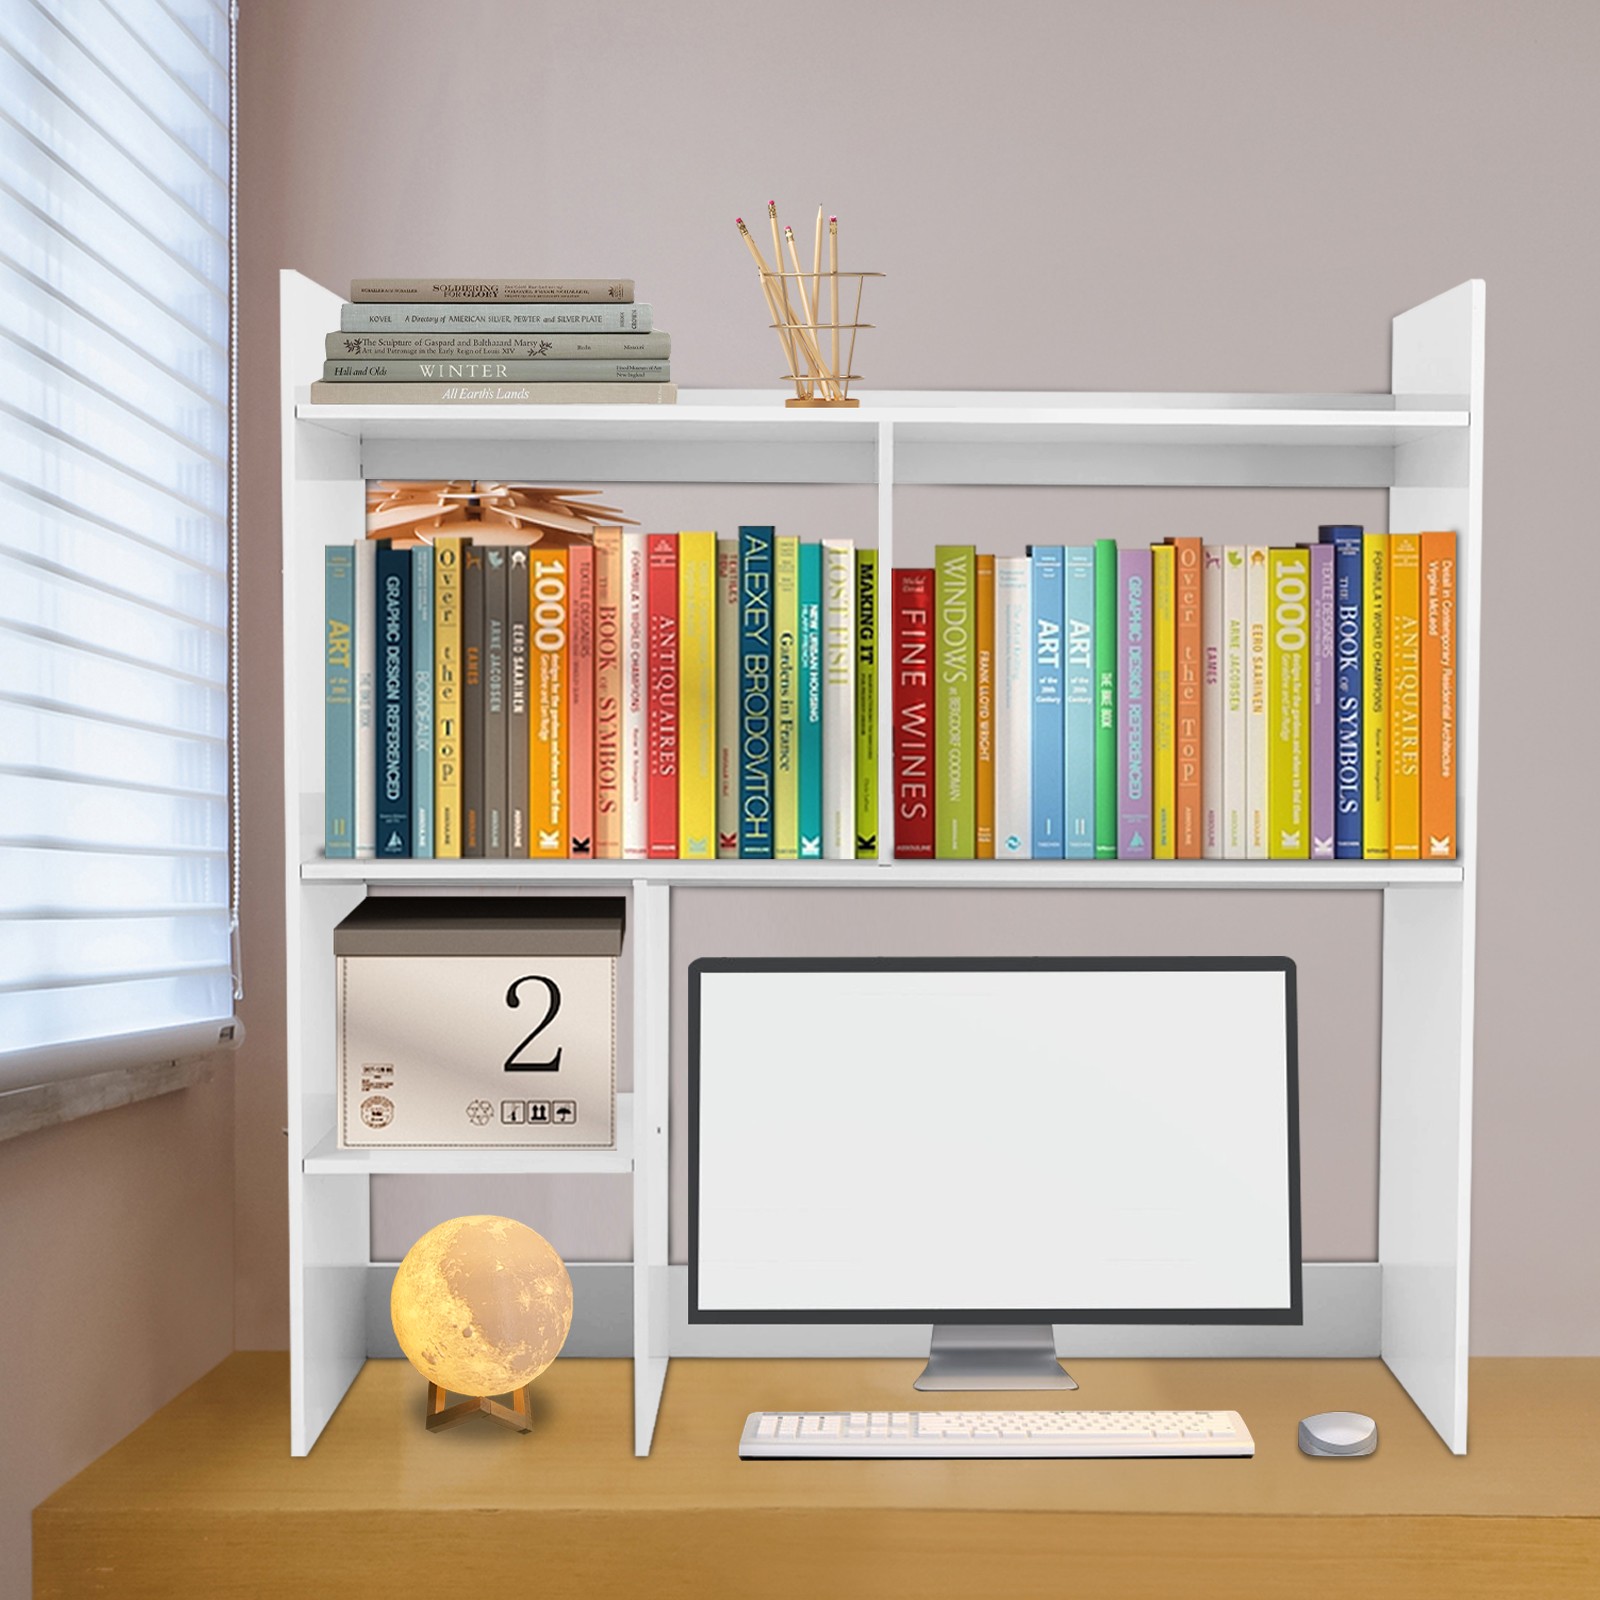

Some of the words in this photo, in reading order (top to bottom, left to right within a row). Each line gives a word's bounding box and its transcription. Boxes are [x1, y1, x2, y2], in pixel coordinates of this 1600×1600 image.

[362, 338, 376, 348] The
[378, 338, 412, 348] Sculpture
[414, 338, 422, 348] of
[424, 338, 455, 348] Gaspard
[457, 338, 470, 348] and
[473, 338, 511, 348] Balthazard
[514, 338, 538, 348] Marsy
[405, 316, 410, 324] A
[412, 316, 438, 324] Directory
[440, 316, 446, 324] of
[449, 316, 486, 324] AMERICAN
[488, 316, 511, 324] SILVER,
[514, 316, 540, 324] PEWTER
[543, 316, 555, 324] and
[557, 316, 580, 324] SILVER
[582, 316, 602, 324] PLATE
[334, 367, 351, 376] Hall
[353, 367, 368, 376] and
[369, 367, 387, 376] Olds
[419, 364, 507, 377] WINTER
[442, 388, 457, 399] All
[459, 388, 493, 399] Earth's
[496, 388, 529, 399] Lands
[580, 562, 590, 599] TEXTILE
[630, 551, 640, 602] FORMULA
[728, 554, 737, 604] TEXTILES
[744, 535, 768, 645] ALEXEY
[828, 548, 848, 618] LOST
[1181, 549, 1195, 622] Over
[1322, 560, 1332, 600] TEXTILE
[1339, 577, 1349, 600] THE
[1373, 551, 1382, 602] FORMULA
[1428, 561, 1439, 596] Virginia
[1441, 560, 1451, 587] Detail
[1441, 589, 1451, 598] in
[385, 576, 400, 642] GRAPHIC
[534, 560, 565, 651] 1000
[809, 604, 819, 629] NEW
[860, 563, 873, 641] MAKING
[943, 555, 967, 683] WINDOWS
[1128, 576, 1142, 642] GRAPHIC
[1275, 560, 1306, 651] 1000
[1428, 598, 1439, 636] McLeod
[329, 620, 349, 668] ART
[489, 620, 501, 650] ARNE
[512, 624, 524, 653] EERO
[580, 602, 590, 658] DESIGNERS
[598, 606, 616, 672] BOOK
[630, 612, 640, 649] WORLD
[809, 631, 819, 669] URBAN
[860, 645, 873, 665] IT
[901, 610, 926, 686] FINE
[1038, 619, 1059, 668] ART
[1070, 619, 1090, 668] ART
[1229, 620, 1240, 649] ARNE
[1252, 624, 1263, 653] EERO
[1322, 603, 1332, 658] DESIGNERS
[1339, 605, 1358, 672] BOOK
[1373, 612, 1382, 649] WORLD
[1441, 600, 1451, 665] Contemporary
[385, 646, 400, 699] DESIGN
[467, 647, 478, 685] EAMES
[630, 651, 640, 712] CHAMPIONS
[779, 633, 794, 697] Gardens
[828, 627, 848, 686] FISH
[979, 651, 989, 683] FRANK
[1100, 673, 1112, 687] THE
[1128, 646, 1142, 699] DESIGN
[1183, 647, 1194, 700] the
[1206, 647, 1217, 685] EAMES
[1373, 651, 1382, 712] CHAMPIONS
[489, 654, 501, 712] JACOBSEN
[512, 656, 524, 713] SAARINEN
[656, 616, 675, 776] ANTIQUAIRES
[779, 700, 794, 715] in
[809, 672, 819, 722] HOUSING
[979, 686, 989, 718] LLOYD
[1100, 690, 1112, 706] BIKE
[1229, 653, 1240, 712] JACOBSEN
[1252, 656, 1263, 713] SAARINEN
[1340, 676, 1348, 692] OF
[1399, 616, 1418, 776] ANTIQUAIRES
[1441, 667, 1451, 719] Residential
[416, 671, 429, 752] BORDEAUX
[948, 697, 960, 747] BERGDORF
[1100, 709, 1112, 728] BOOK
[385, 704, 400, 800] REFERENCED
[598, 697, 616, 813] SYMBOLS
[744, 655, 768, 837] BRODOVITCH
[779, 720, 794, 771] France
[901, 703, 926, 820] WINES
[979, 721, 989, 762] WRIGHT
[1128, 704, 1142, 800] REFERENCED
[1182, 719, 1194, 781] Top
[1339, 697, 1358, 813] SYMBOLS
[1441, 721, 1451, 777] Architecture
[948, 749, 960, 801] GOODMAN
[504, 975, 562, 1072] 2
